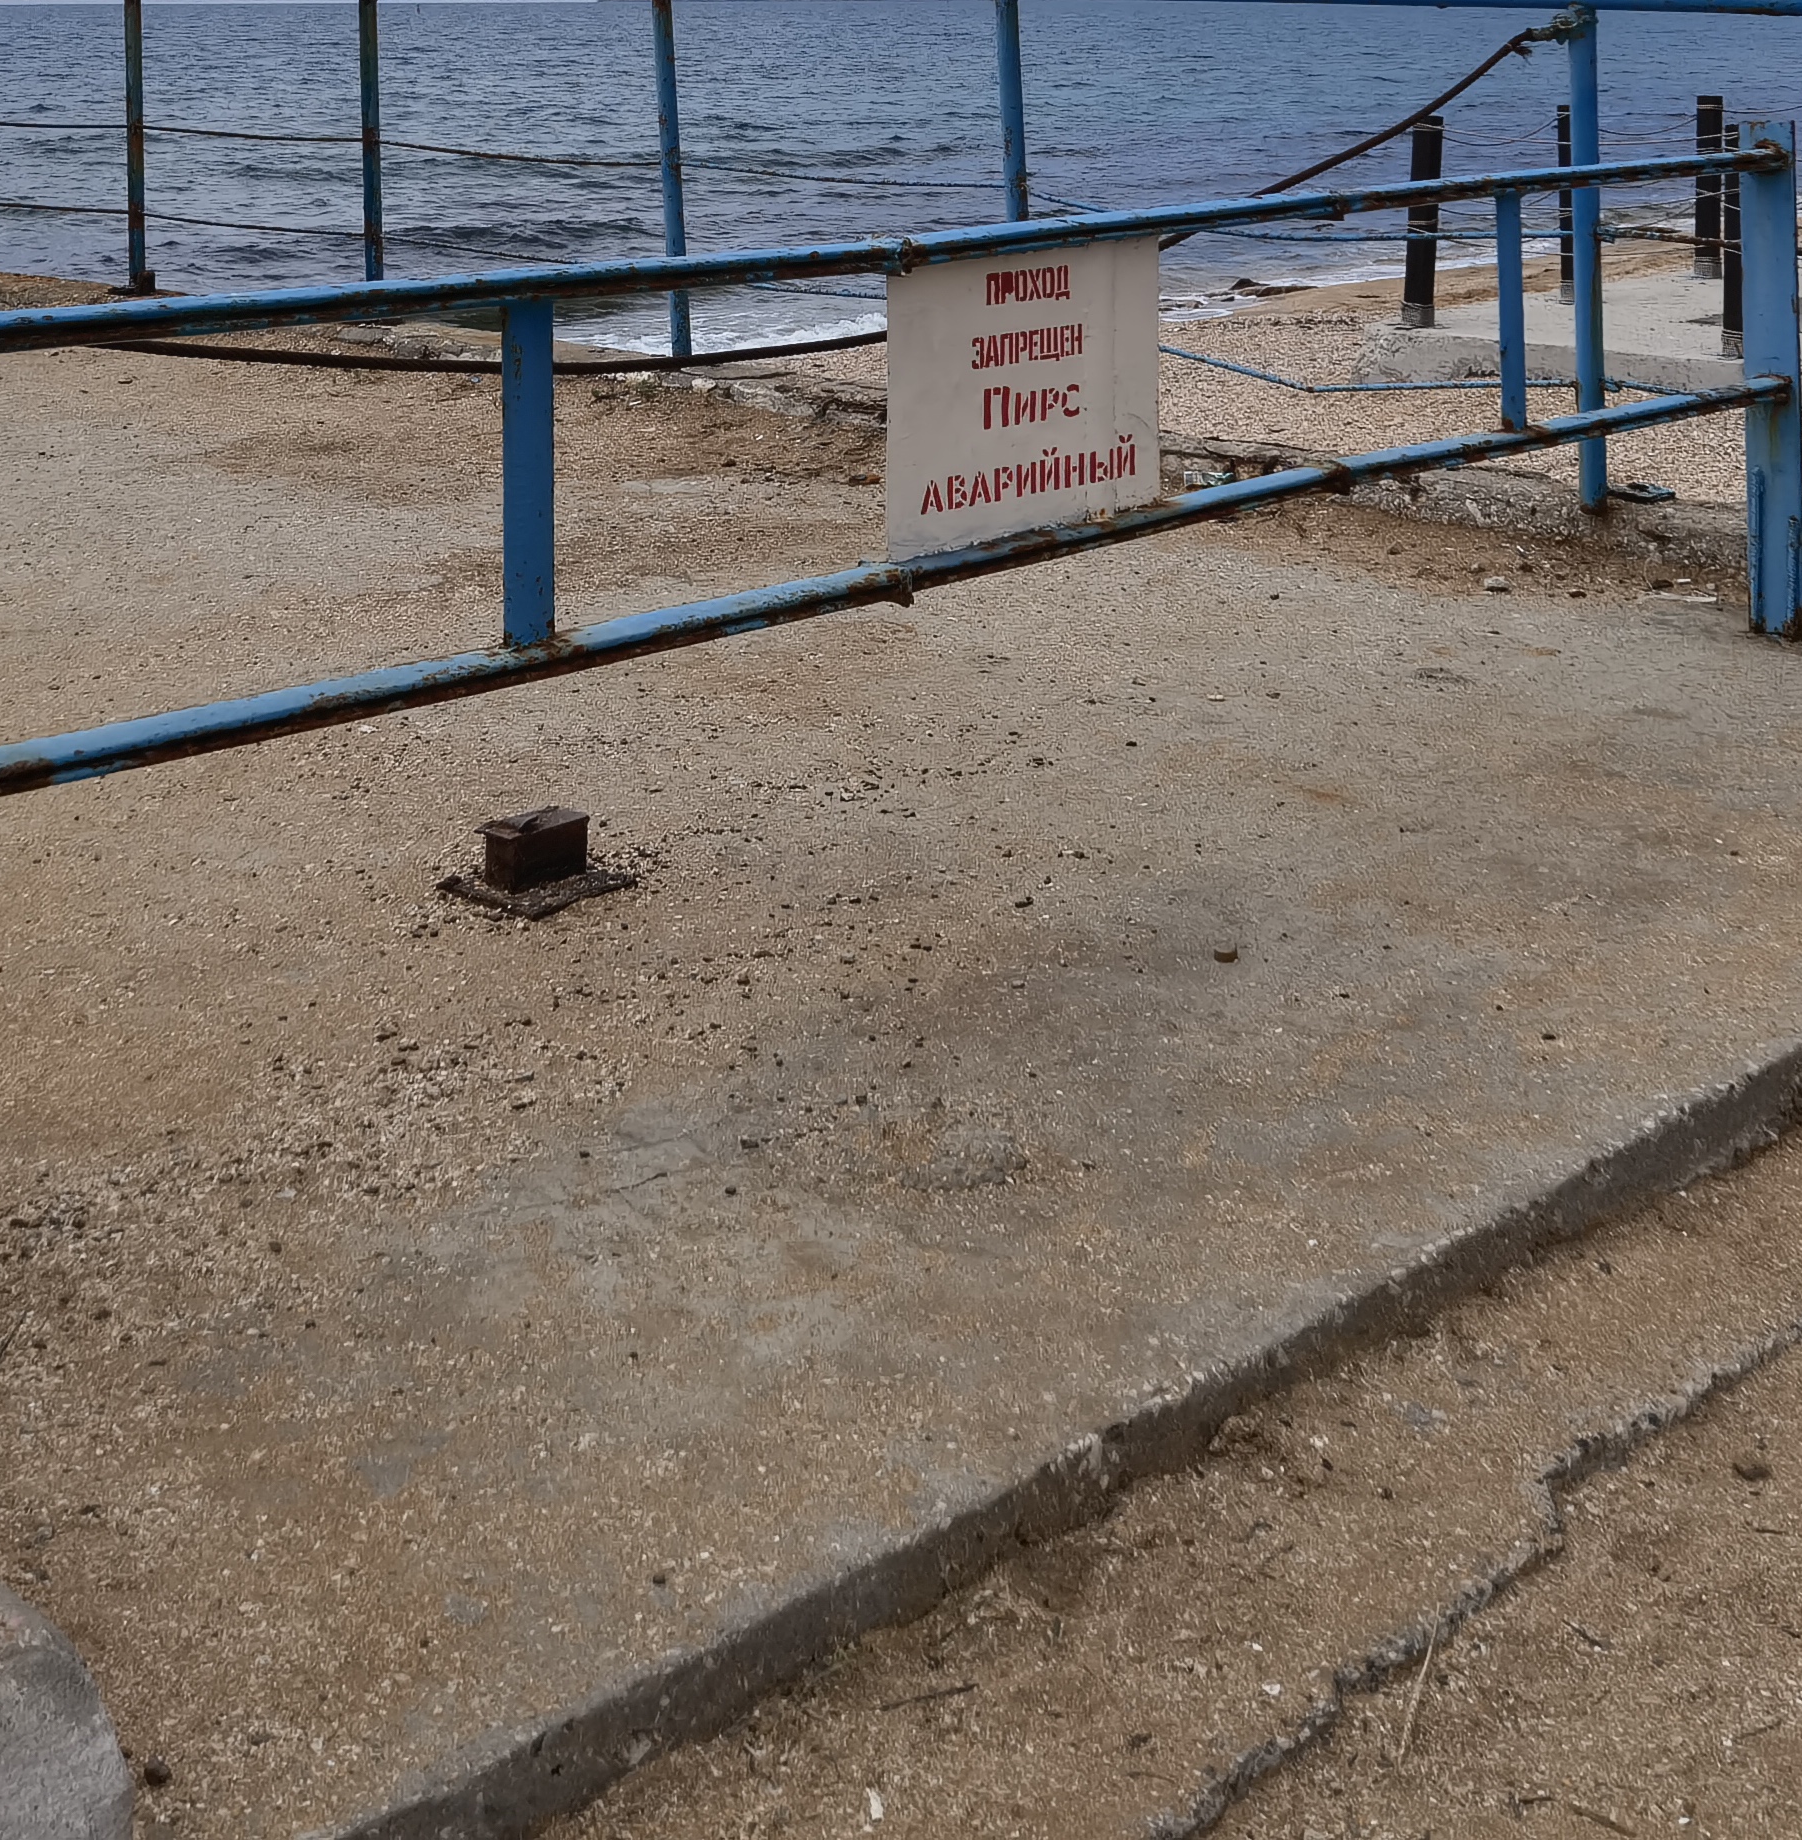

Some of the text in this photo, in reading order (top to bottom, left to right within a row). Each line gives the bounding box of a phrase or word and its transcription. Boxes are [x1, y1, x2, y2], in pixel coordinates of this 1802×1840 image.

[985, 265, 1071, 305] ПРОХОД
[971, 323, 1084, 370] ЗАПРЕЩЕН
[920, 433, 1136, 515] АВАРИЙНЫЙ
